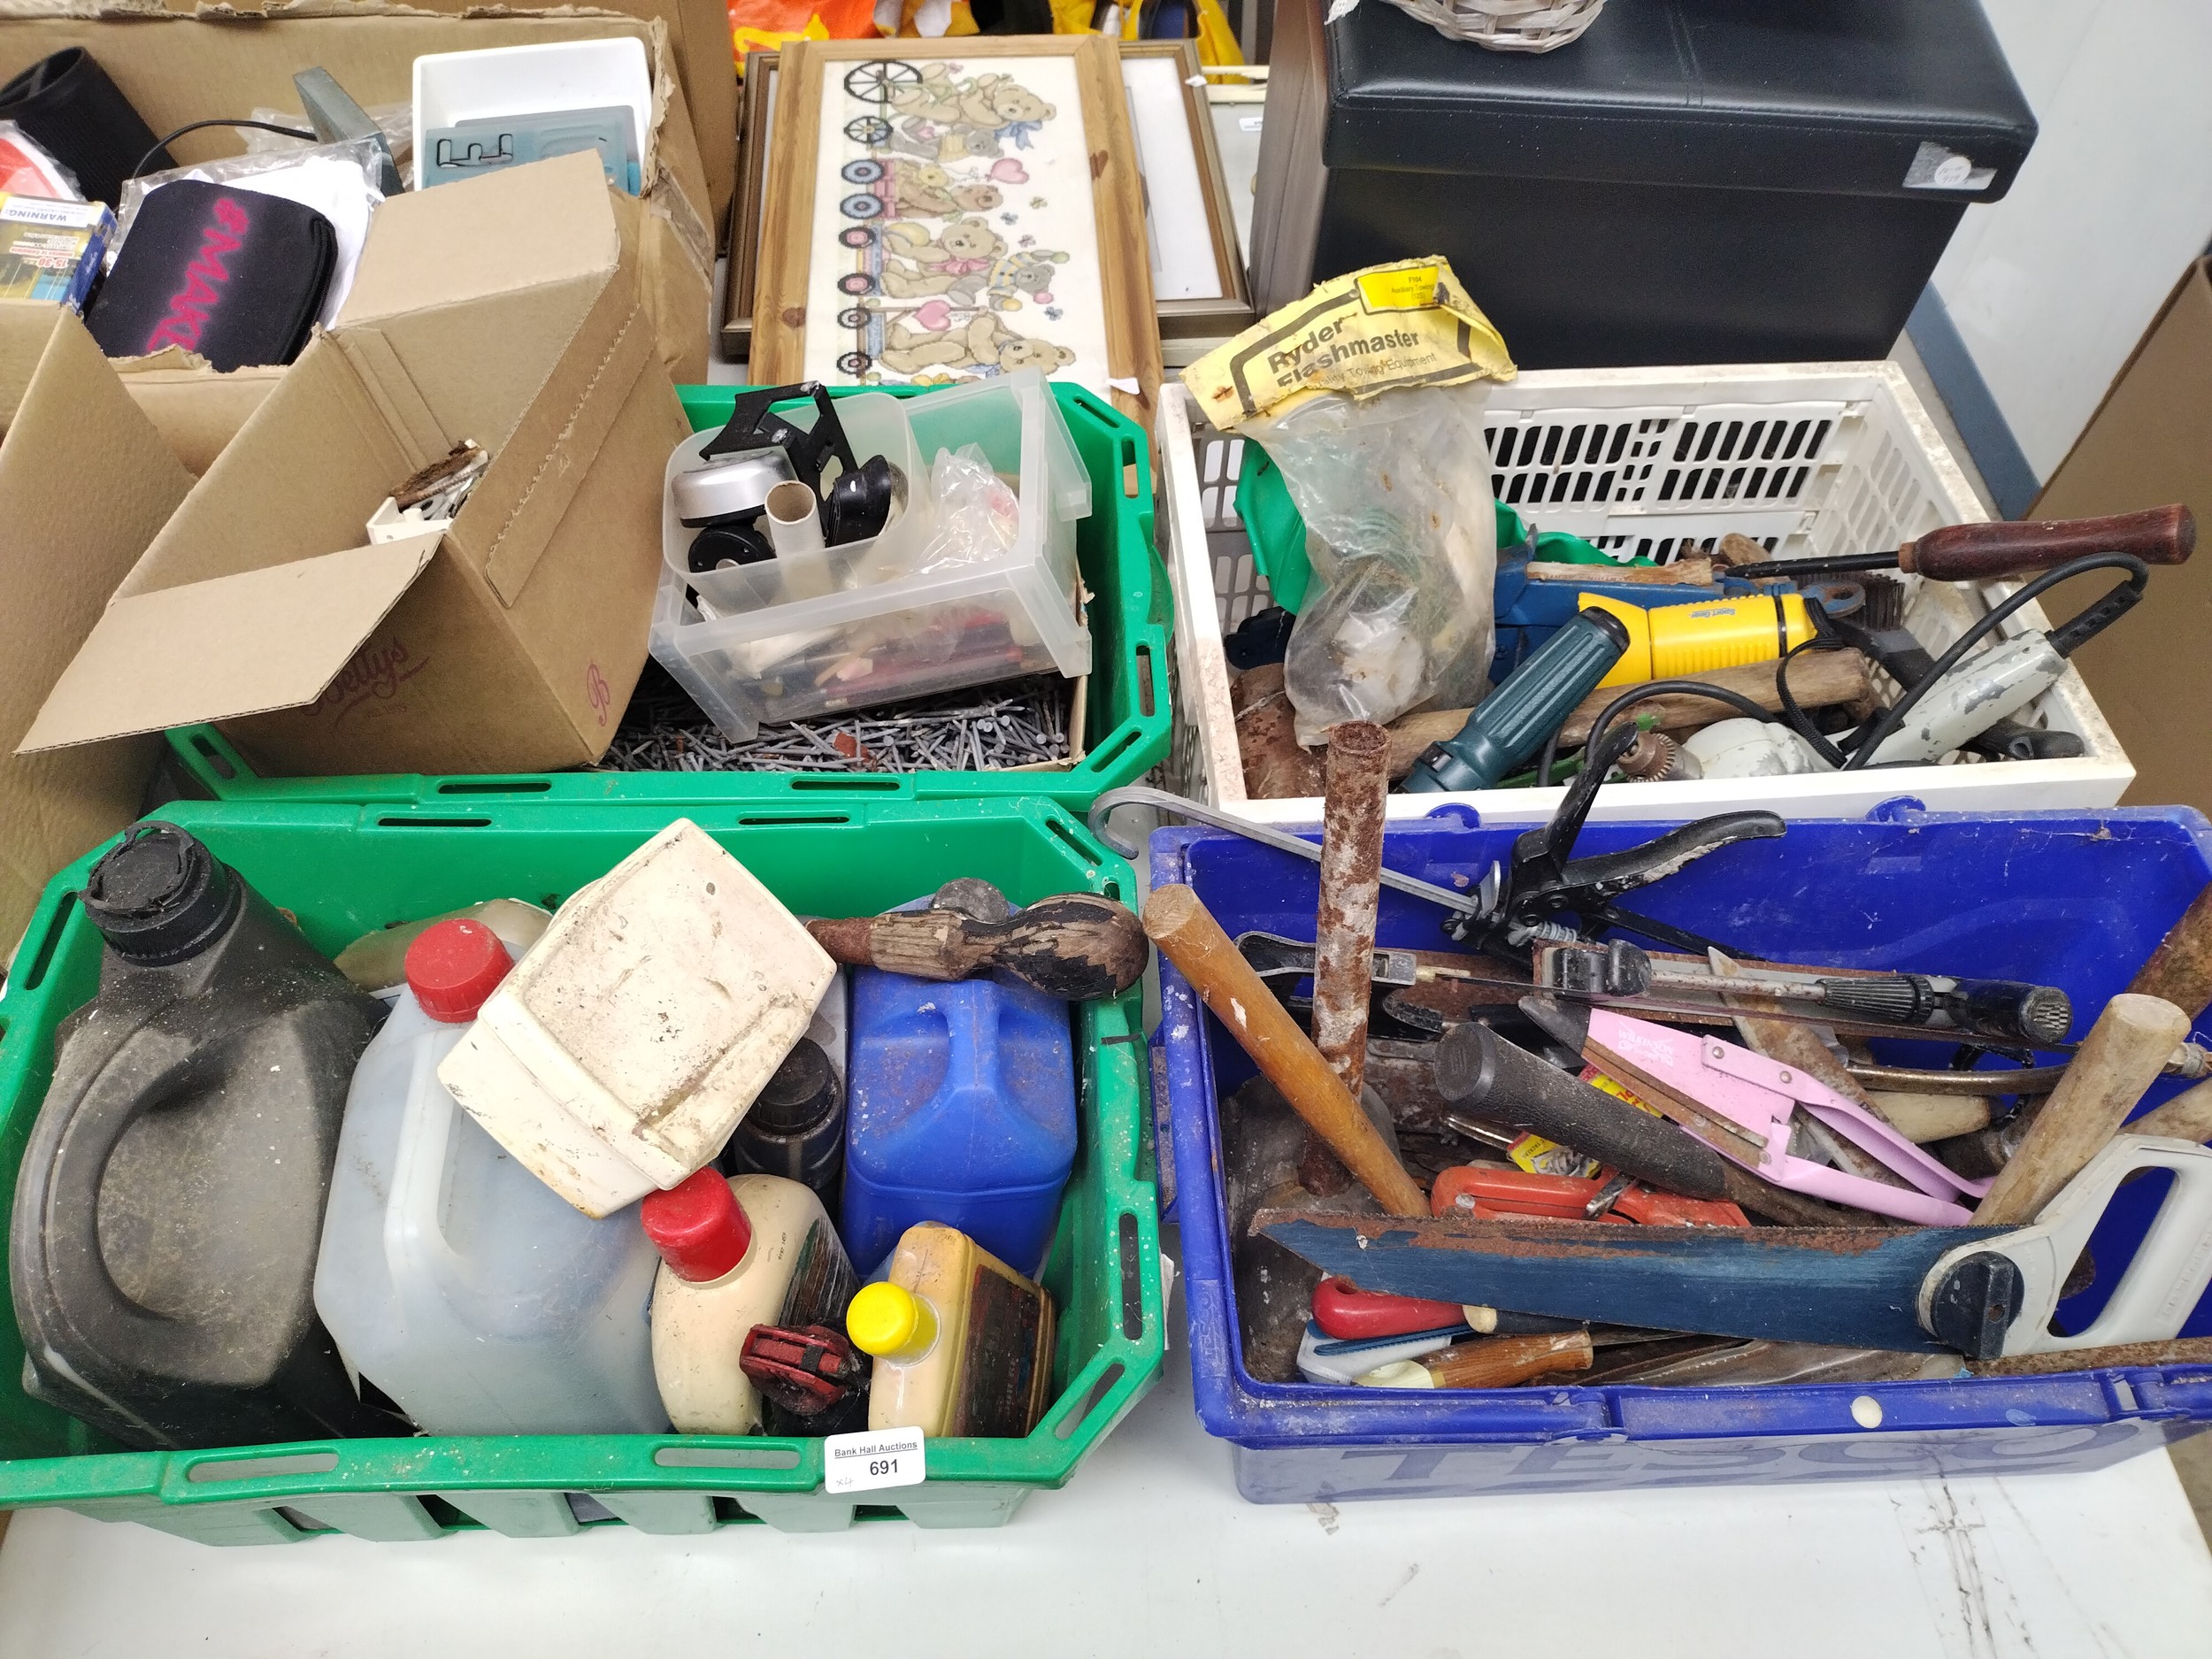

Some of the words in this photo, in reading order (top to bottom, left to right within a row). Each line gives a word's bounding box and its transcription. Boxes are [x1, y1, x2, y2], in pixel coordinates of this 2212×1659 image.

[1267, 317, 1343, 374] Ryder
[1387, 352, 1438, 371] Equipment
[1617, 1028, 1674, 1058] WILKINSON
[834, 1448, 856, 1457] Bank
[859, 1445, 876, 1454] Hall
[879, 1441, 918, 1452] Auctions
[1341, 1423, 2139, 1481] TESCO
[870, 1458, 898, 1476] 691
